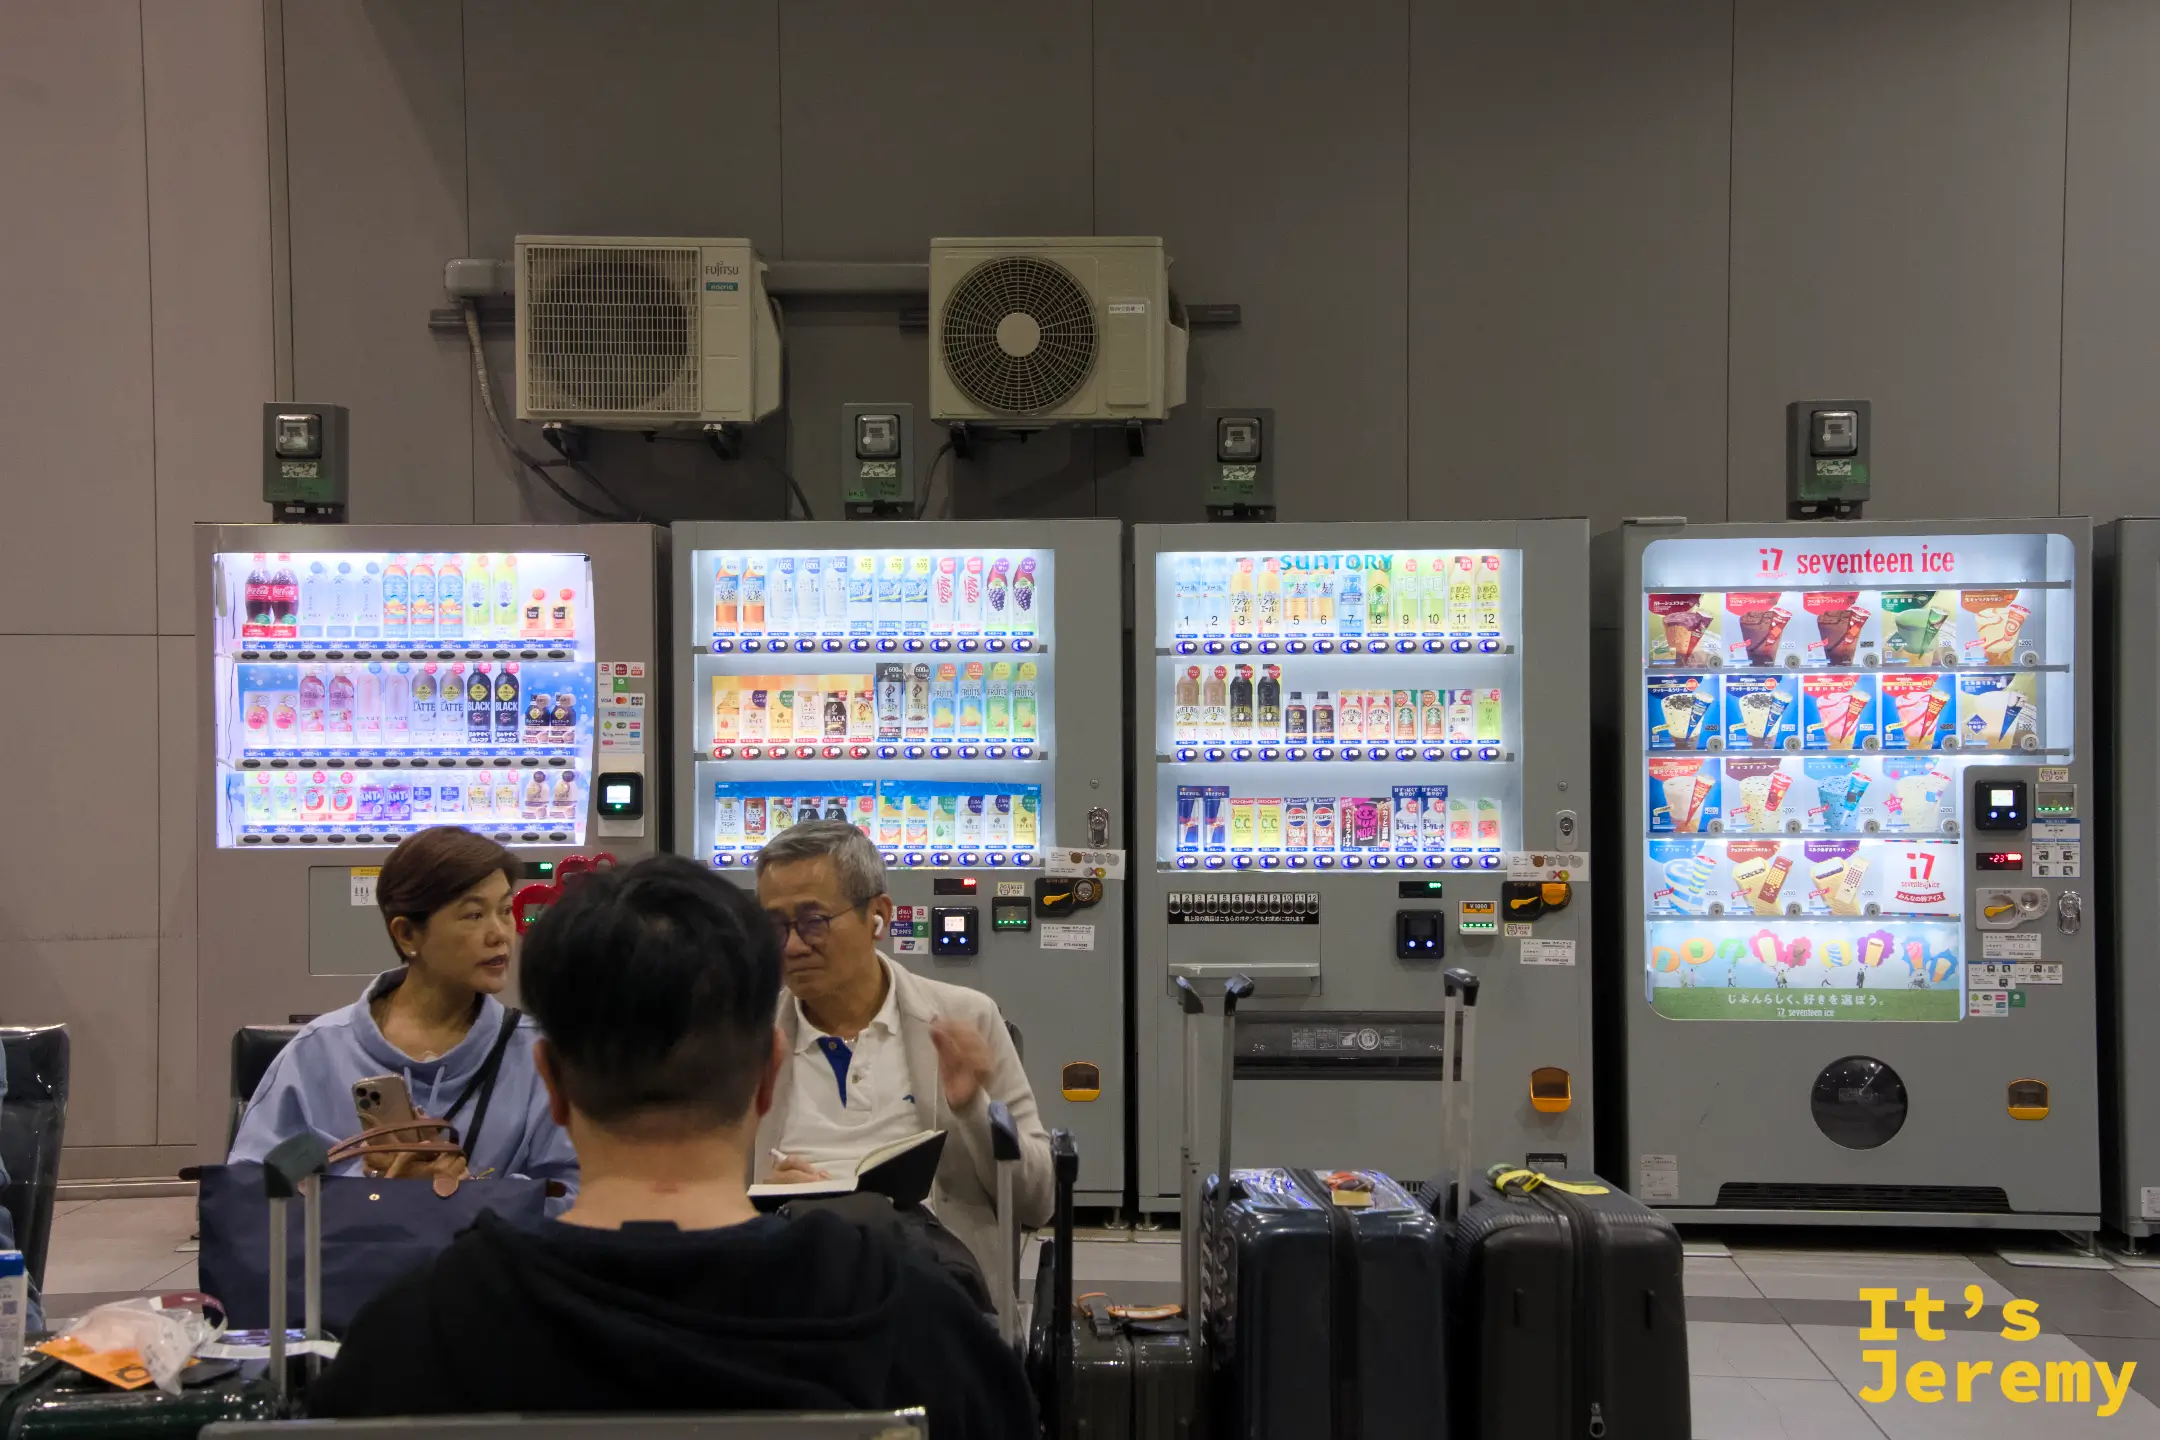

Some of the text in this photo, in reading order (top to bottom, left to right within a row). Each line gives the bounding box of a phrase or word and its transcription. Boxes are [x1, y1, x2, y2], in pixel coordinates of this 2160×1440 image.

[705, 261, 739, 276] FUJITSU
[1280, 554, 1393, 571] SUNTORY
[1797, 544, 1955, 574] seventeen ice
[1184, 613, 1495, 626] 1 2 3 4 5 6 7 8 9 10 11 12
[468, 701, 490, 711] BLACK
[495, 701, 518, 711] BLACK
[1356, 827, 1376, 839] NOPE
[1788, 1008, 1823, 1017] seventeen
